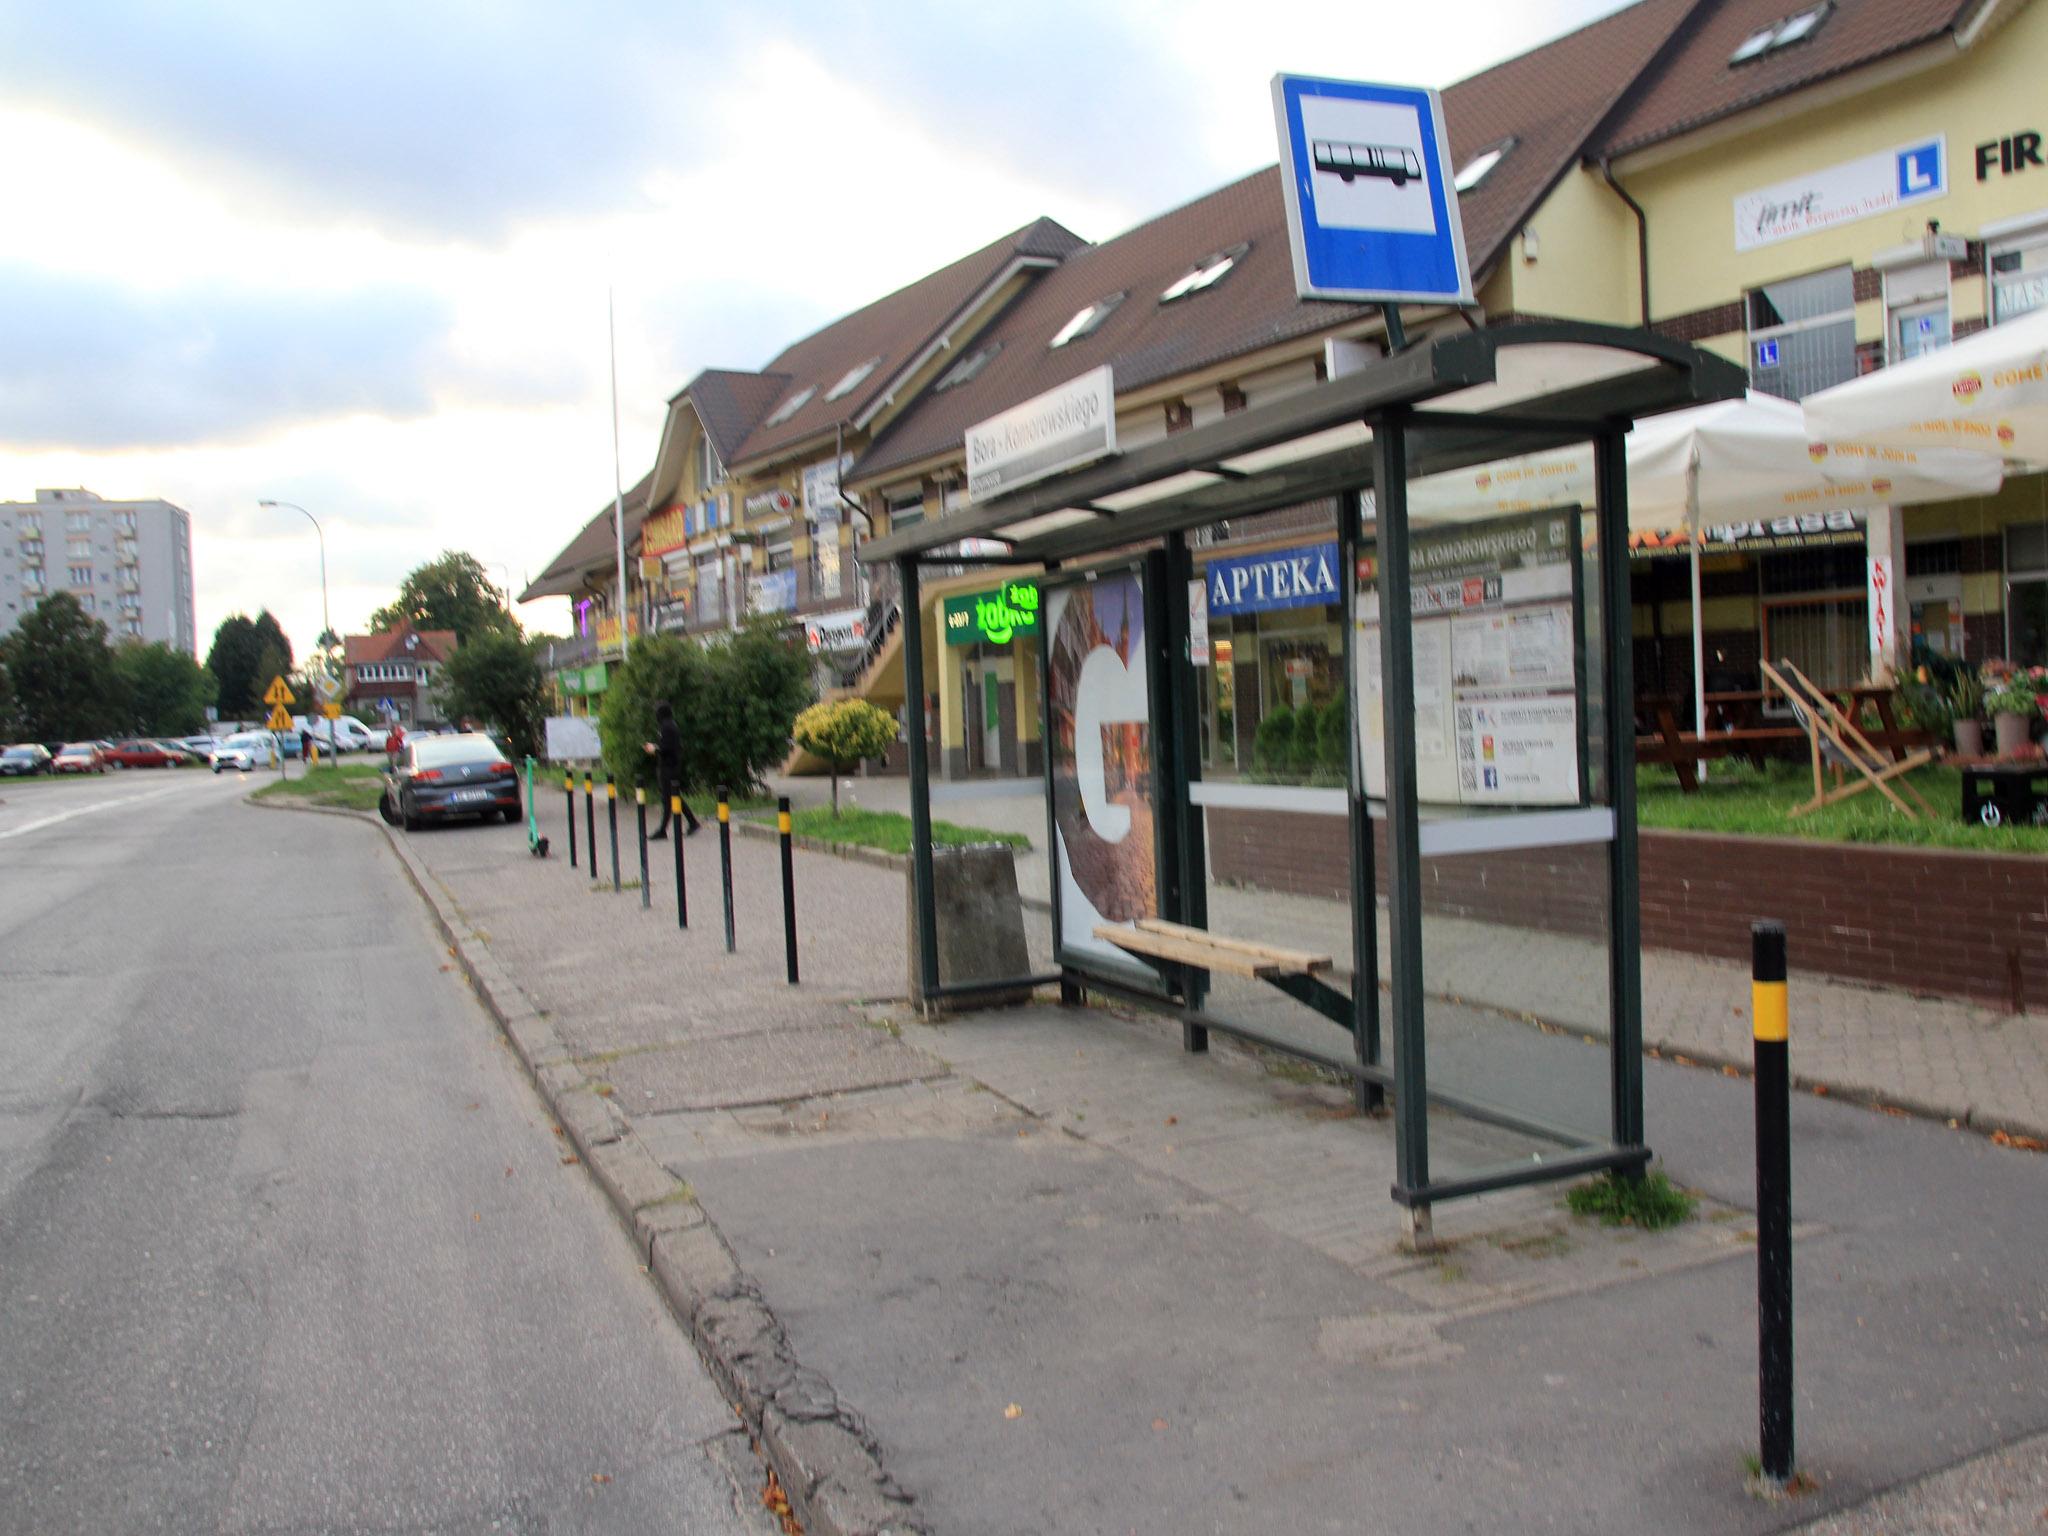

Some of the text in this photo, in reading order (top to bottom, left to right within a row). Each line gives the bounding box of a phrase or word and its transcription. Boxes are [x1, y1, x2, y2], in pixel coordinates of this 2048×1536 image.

[1905, 155, 1932, 192] L
[1974, 127, 2048, 183] FIR
[972, 435, 997, 466] Bora
[1004, 389, 1100, 452] Komorowskiego
[1211, 554, 1335, 607] APTEKA
